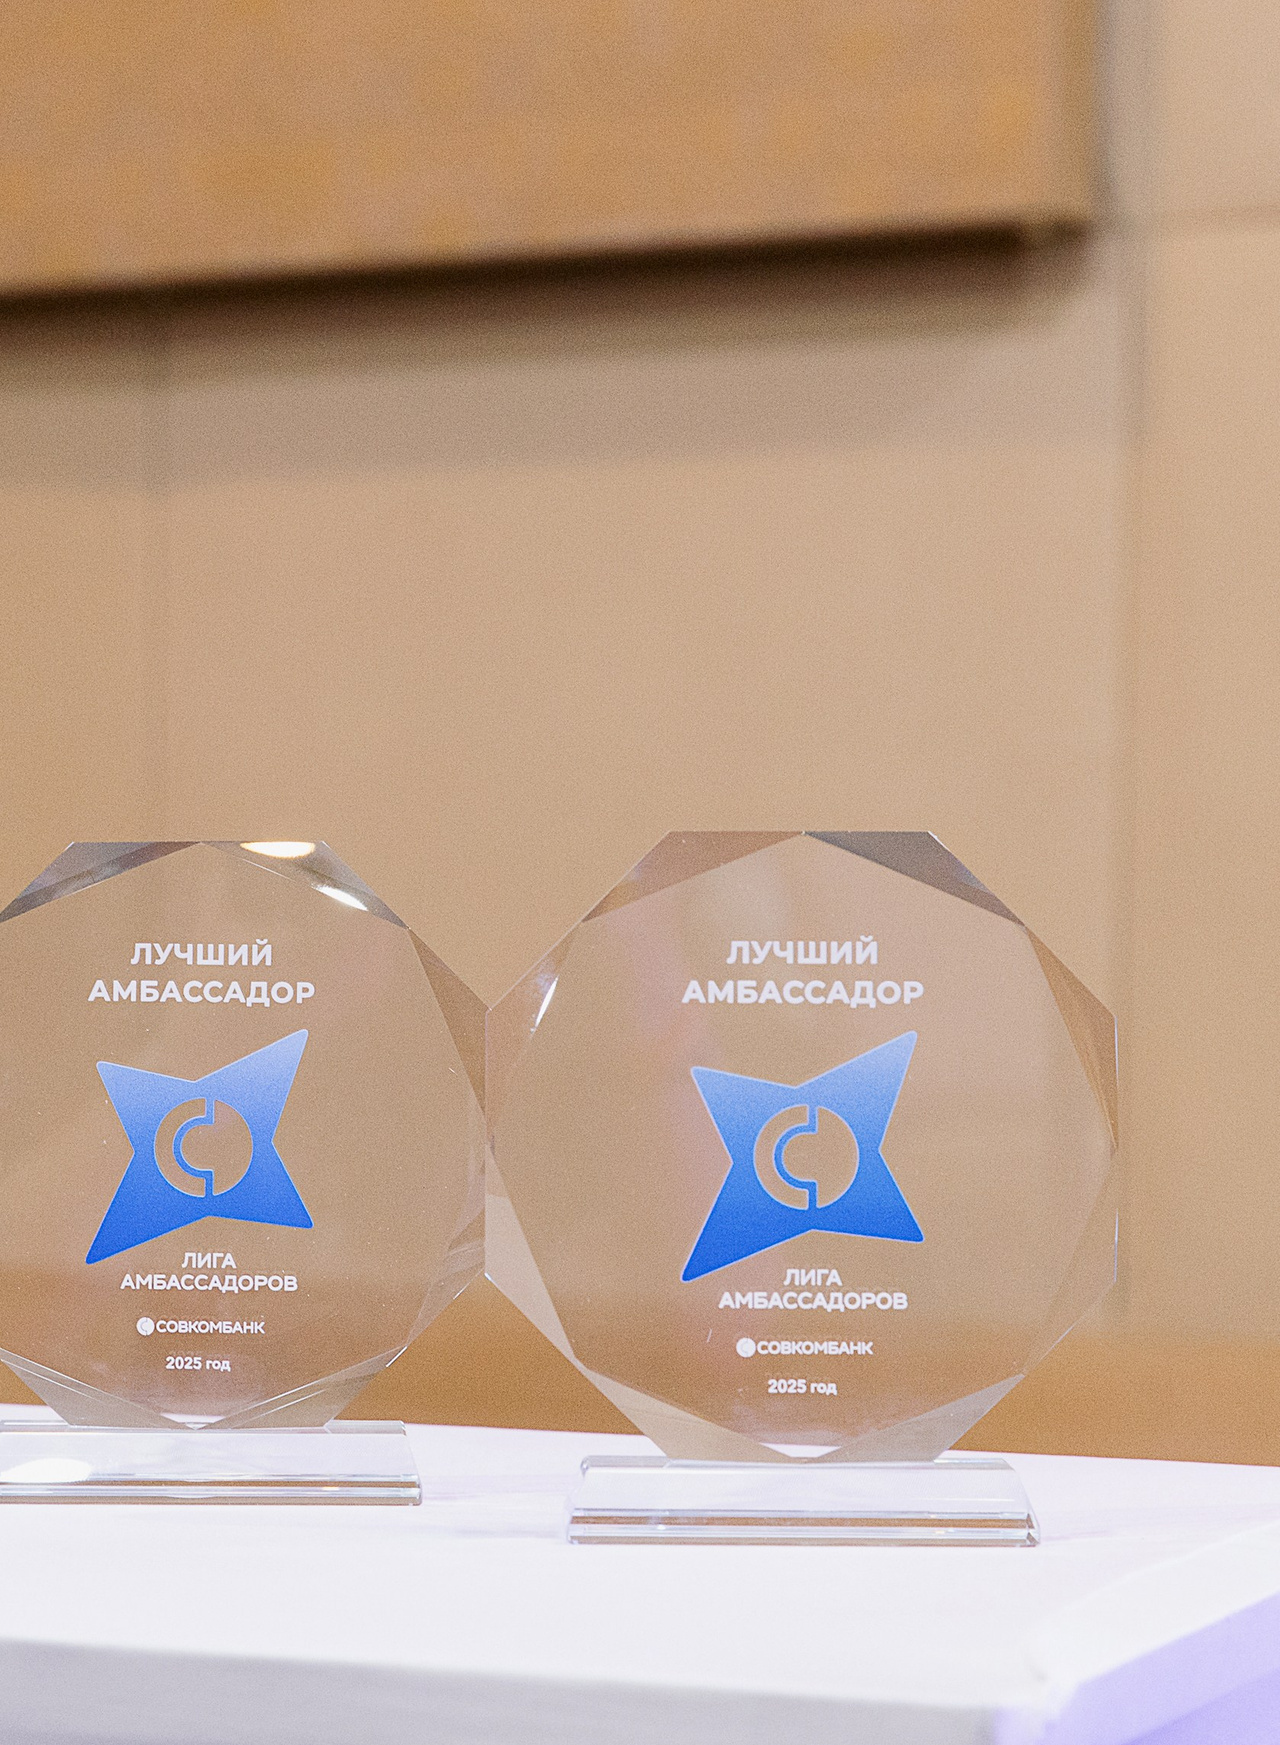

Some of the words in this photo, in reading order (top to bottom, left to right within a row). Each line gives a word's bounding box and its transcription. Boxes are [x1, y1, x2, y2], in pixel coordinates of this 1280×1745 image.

[130, 938, 272, 967] ЛУЧШИЙ
[726, 934, 879, 965] ЛУЧШИЙ
[88, 979, 316, 1008] АМБАССАДОР
[681, 979, 925, 1009] АМБАССАДОР
[181, 1251, 237, 1269] ЛИГА
[120, 1273, 298, 1294] АМБАССАДОРОВ
[783, 1268, 843, 1287] ЛИГА
[718, 1290, 909, 1313] АМБАССАДОРОВ
[155, 1319, 266, 1334] СОВКОМБАНК
[756, 1340, 874, 1355] СОВКОМБАНК
[165, 1355, 203, 1371] 2025
[205, 1359, 232, 1372] год
[767, 1378, 807, 1394] 2025
[810, 1382, 838, 1396] год
